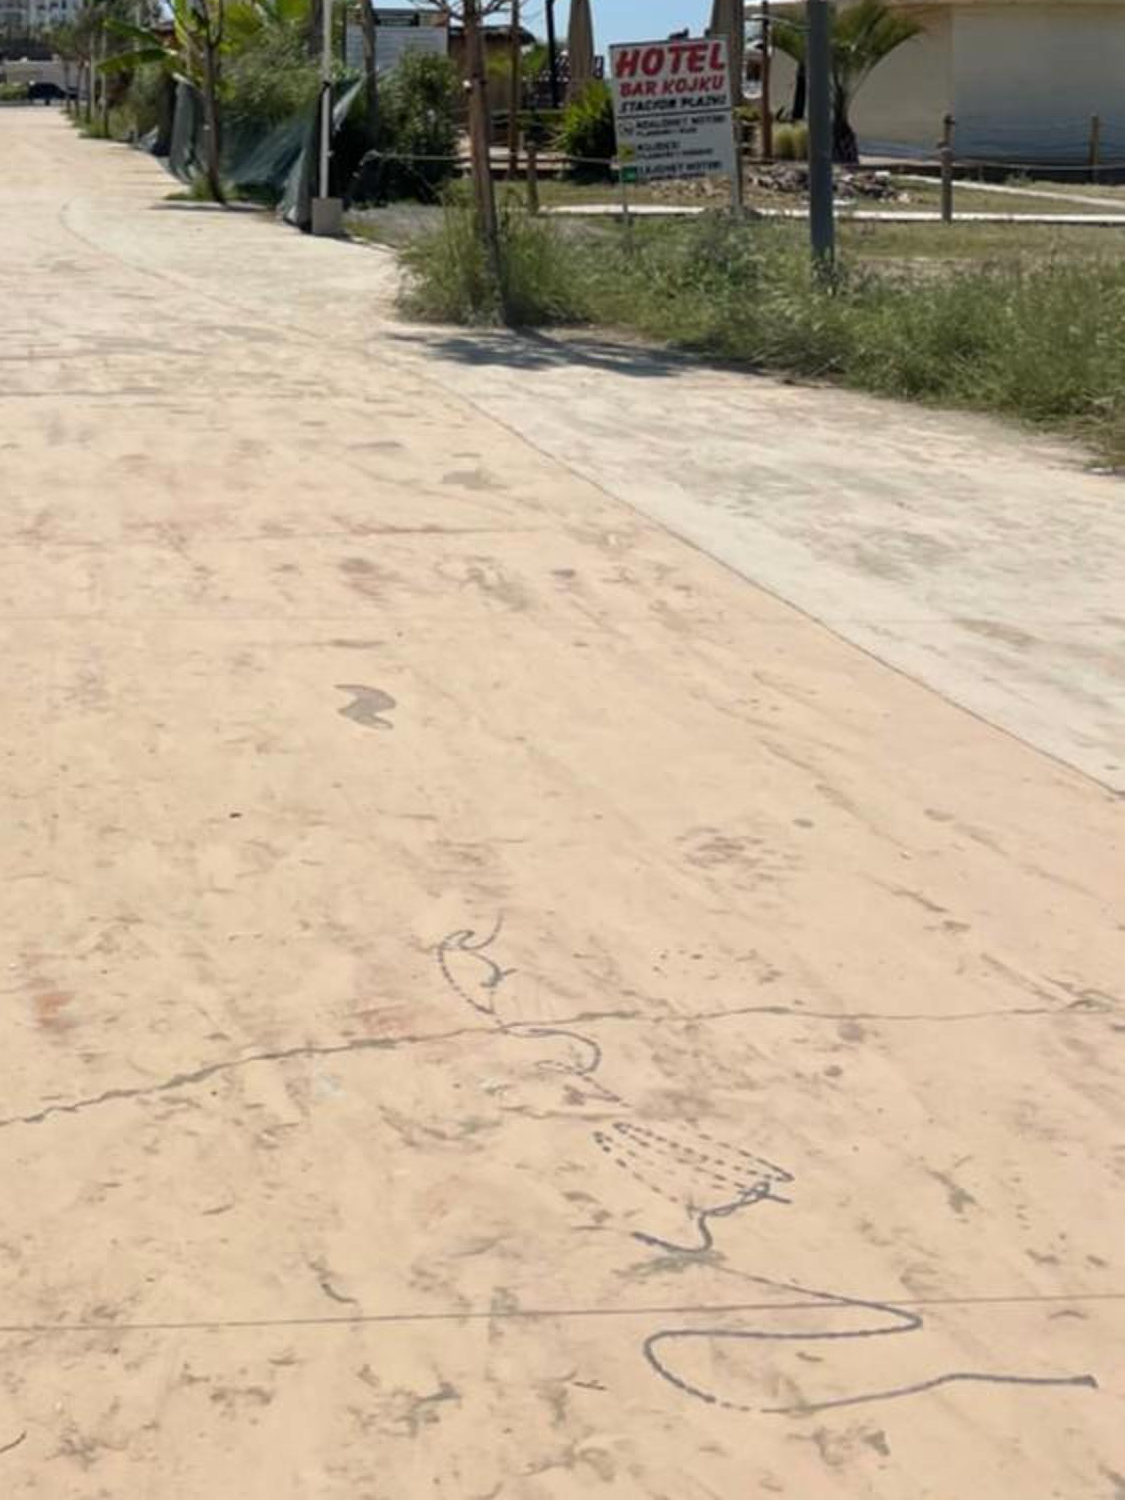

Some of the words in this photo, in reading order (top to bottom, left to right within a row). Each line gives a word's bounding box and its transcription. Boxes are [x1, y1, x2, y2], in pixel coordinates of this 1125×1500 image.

[616, 43, 725, 77] HOTEL
[620, 82, 656, 97] BAR
[663, 76, 724, 94] KOJKU
